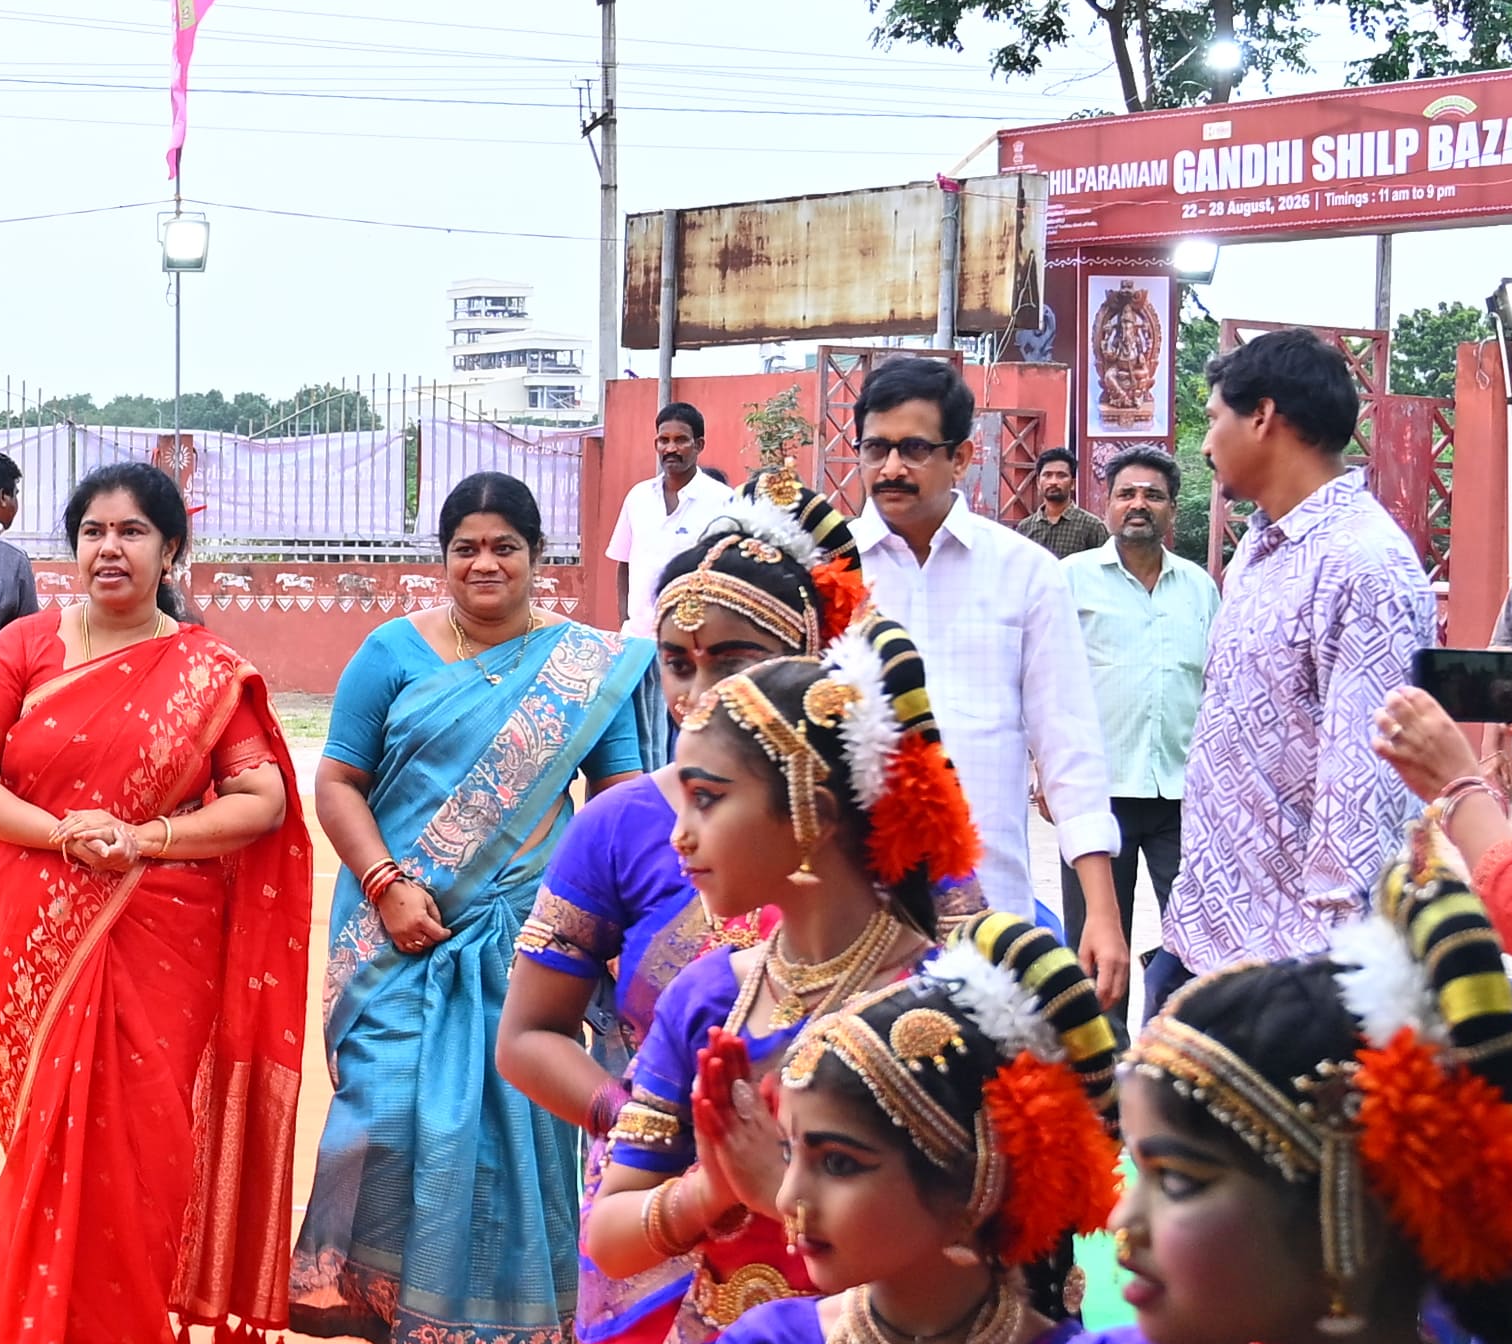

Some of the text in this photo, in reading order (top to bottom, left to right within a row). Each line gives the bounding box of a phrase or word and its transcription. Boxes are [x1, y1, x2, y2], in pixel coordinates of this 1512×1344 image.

[1041, 159, 1168, 196] HILPARAMAM
[1173, 139, 1304, 194] GANDHI
[1311, 128, 1419, 182] SHILP
[1208, 201, 1225, 216] 28
[1227, 197, 1275, 217] August,
[1277, 194, 1310, 211] 2026
[1324, 190, 1369, 208] Timings
[1378, 187, 1389, 203] 11
[1391, 188, 1409, 202] am
[1412, 186, 1424, 200] to
[1426, 184, 1434, 199] 9
[1436, 185, 1456, 201] pm
